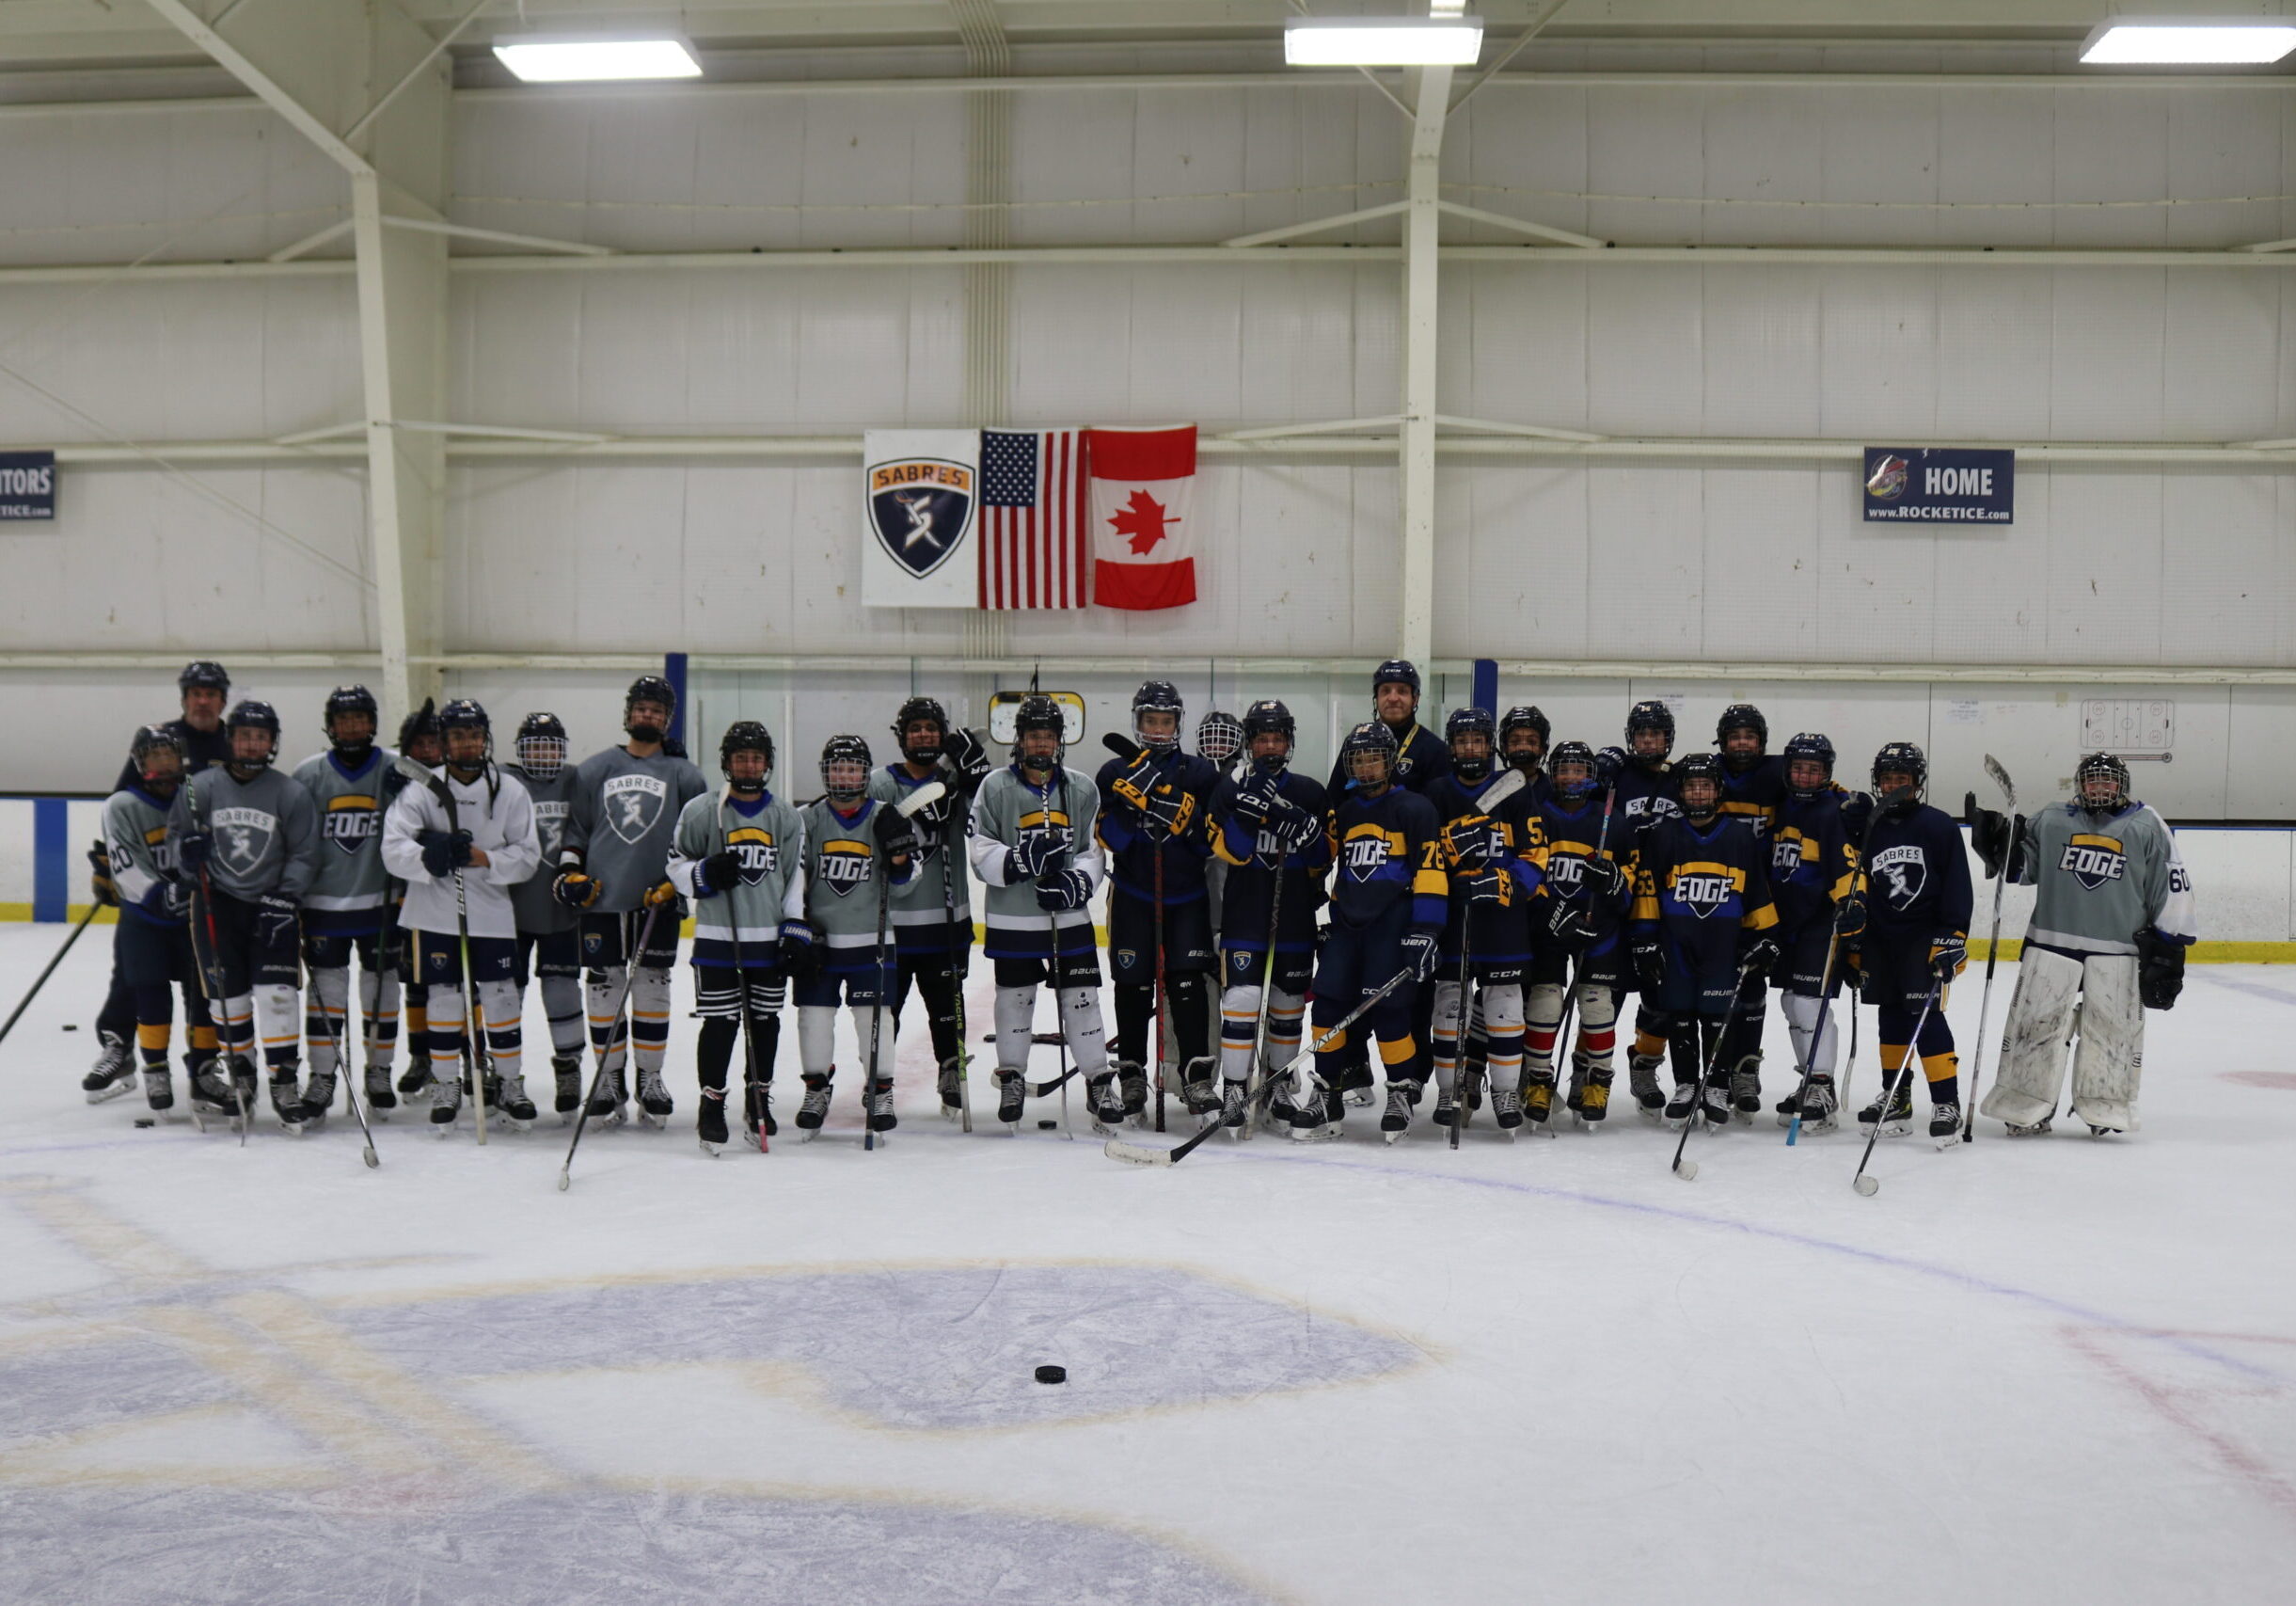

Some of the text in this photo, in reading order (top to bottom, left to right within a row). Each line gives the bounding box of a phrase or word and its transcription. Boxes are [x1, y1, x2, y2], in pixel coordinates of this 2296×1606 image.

[0, 467, 51, 496] TORS
[877, 465, 964, 486] SABRES
[1925, 468, 1993, 496] HOME
[1868, 505, 2010, 520] www.ROCKETICE.com
[606, 776, 663, 792] SABRES
[215, 810, 270, 829] SABRES
[323, 811, 381, 838] EDGE
[724, 843, 780, 872] DGE
[818, 853, 875, 883] EDGE
[1421, 840, 1446, 870] 76
[1876, 849, 1920, 867] SABRES
[2058, 845, 2128, 881] EDGE
[1546, 856, 1585, 884] EDG
[2169, 868, 2190, 893] 60
[1673, 876, 1735, 904] EDGE
[1489, 969, 1523, 979] CCM
